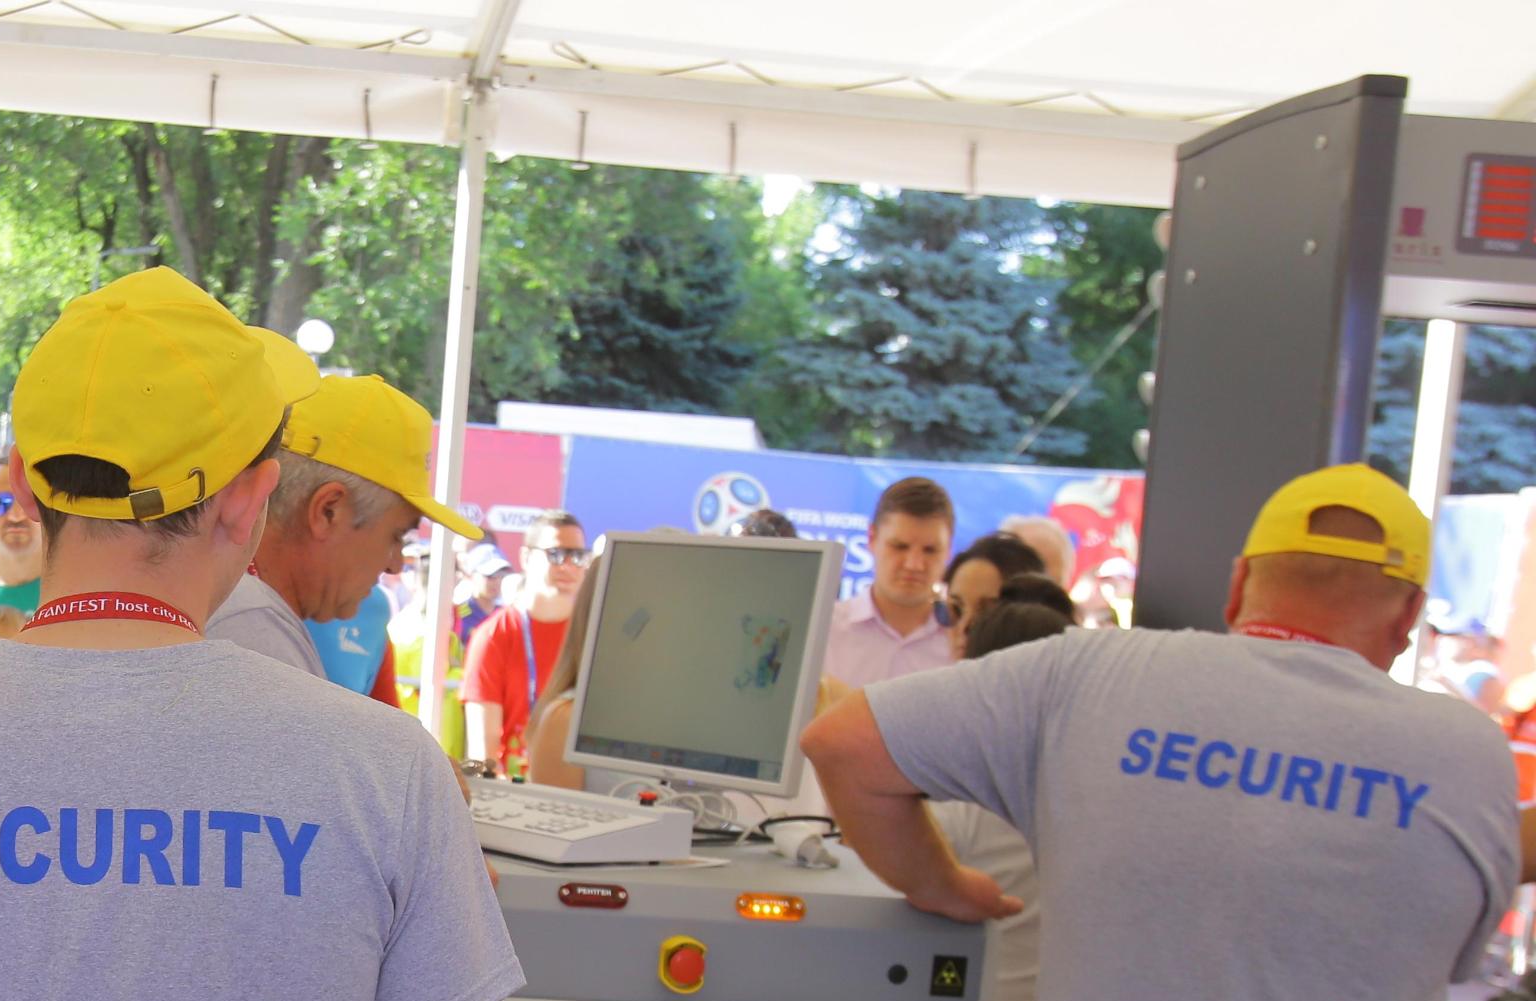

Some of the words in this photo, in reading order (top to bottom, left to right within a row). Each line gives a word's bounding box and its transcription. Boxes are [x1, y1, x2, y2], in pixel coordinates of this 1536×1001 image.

[38, 604, 66, 620] FAN
[69, 598, 108, 613] FEST
[115, 598, 149, 614] host
[152, 606, 176, 623] city
[1120, 728, 1430, 829] SECURITY
[576, 886, 612, 897] РЕНТГЕН
